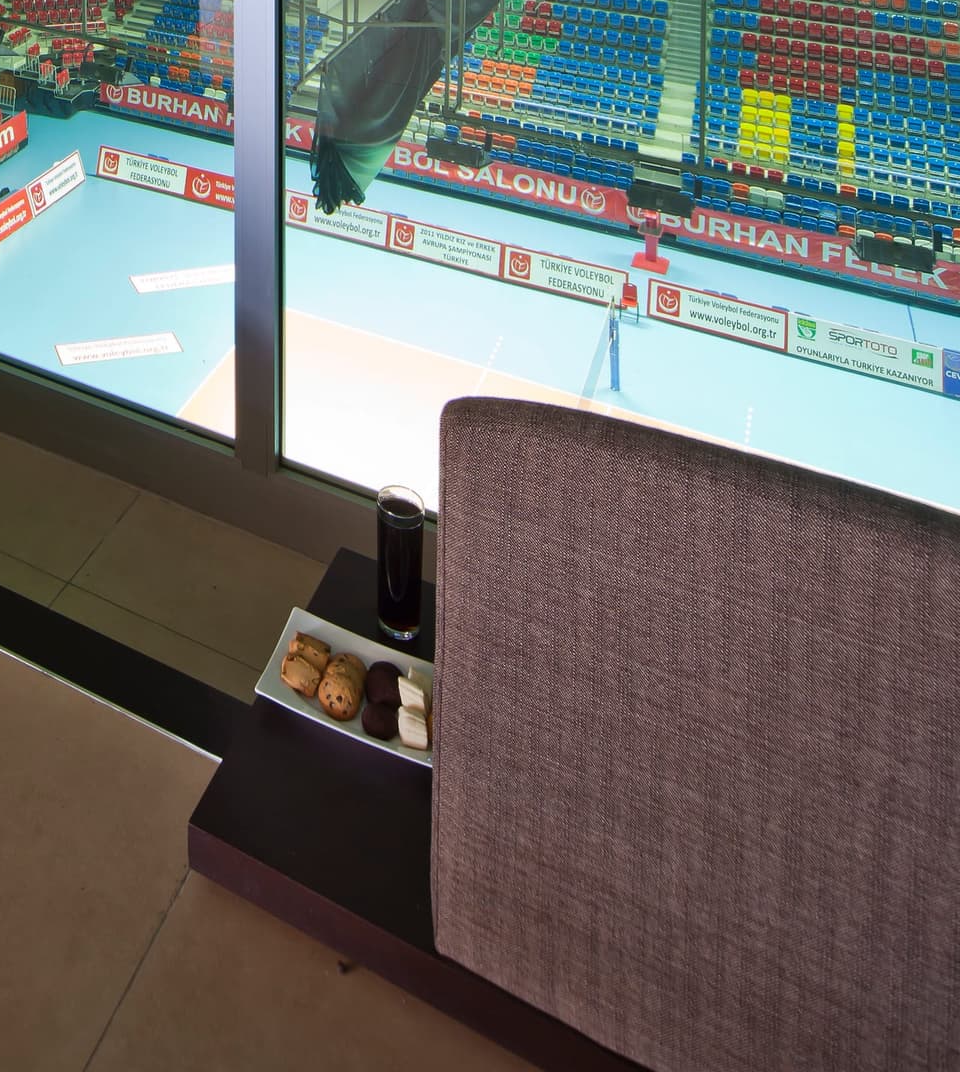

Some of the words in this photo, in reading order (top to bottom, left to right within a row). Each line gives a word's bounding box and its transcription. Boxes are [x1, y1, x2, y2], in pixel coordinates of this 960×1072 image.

[126, 88, 219, 124] BURHAN
[130, 171, 171, 188] FEDERASYONU
[150, 163, 178, 178] VOLEYBOL
[456, 164, 577, 205] SALONU
[313, 215, 381, 238] www.voleybol.org.tr
[420, 228, 435, 237] 2011
[476, 242, 496, 252] ERKEK
[660, 212, 809, 258] BURHAN
[422, 238, 448, 250] AVRUPA
[540, 258, 572, 275] TÜRKİYE
[574, 267, 614, 285] VOLEYBOL
[548, 276, 605, 298] FEDERASYONU
[688, 294, 710, 307] Türkiye
[711, 300, 738, 313] Voleybol
[739, 308, 780, 324] Federasyonu
[689, 309, 777, 339] www.voleybol.org.tr
[796, 345, 850, 366] OYUNLARIYLA
[886, 368, 934, 387] KAZANIYOR
